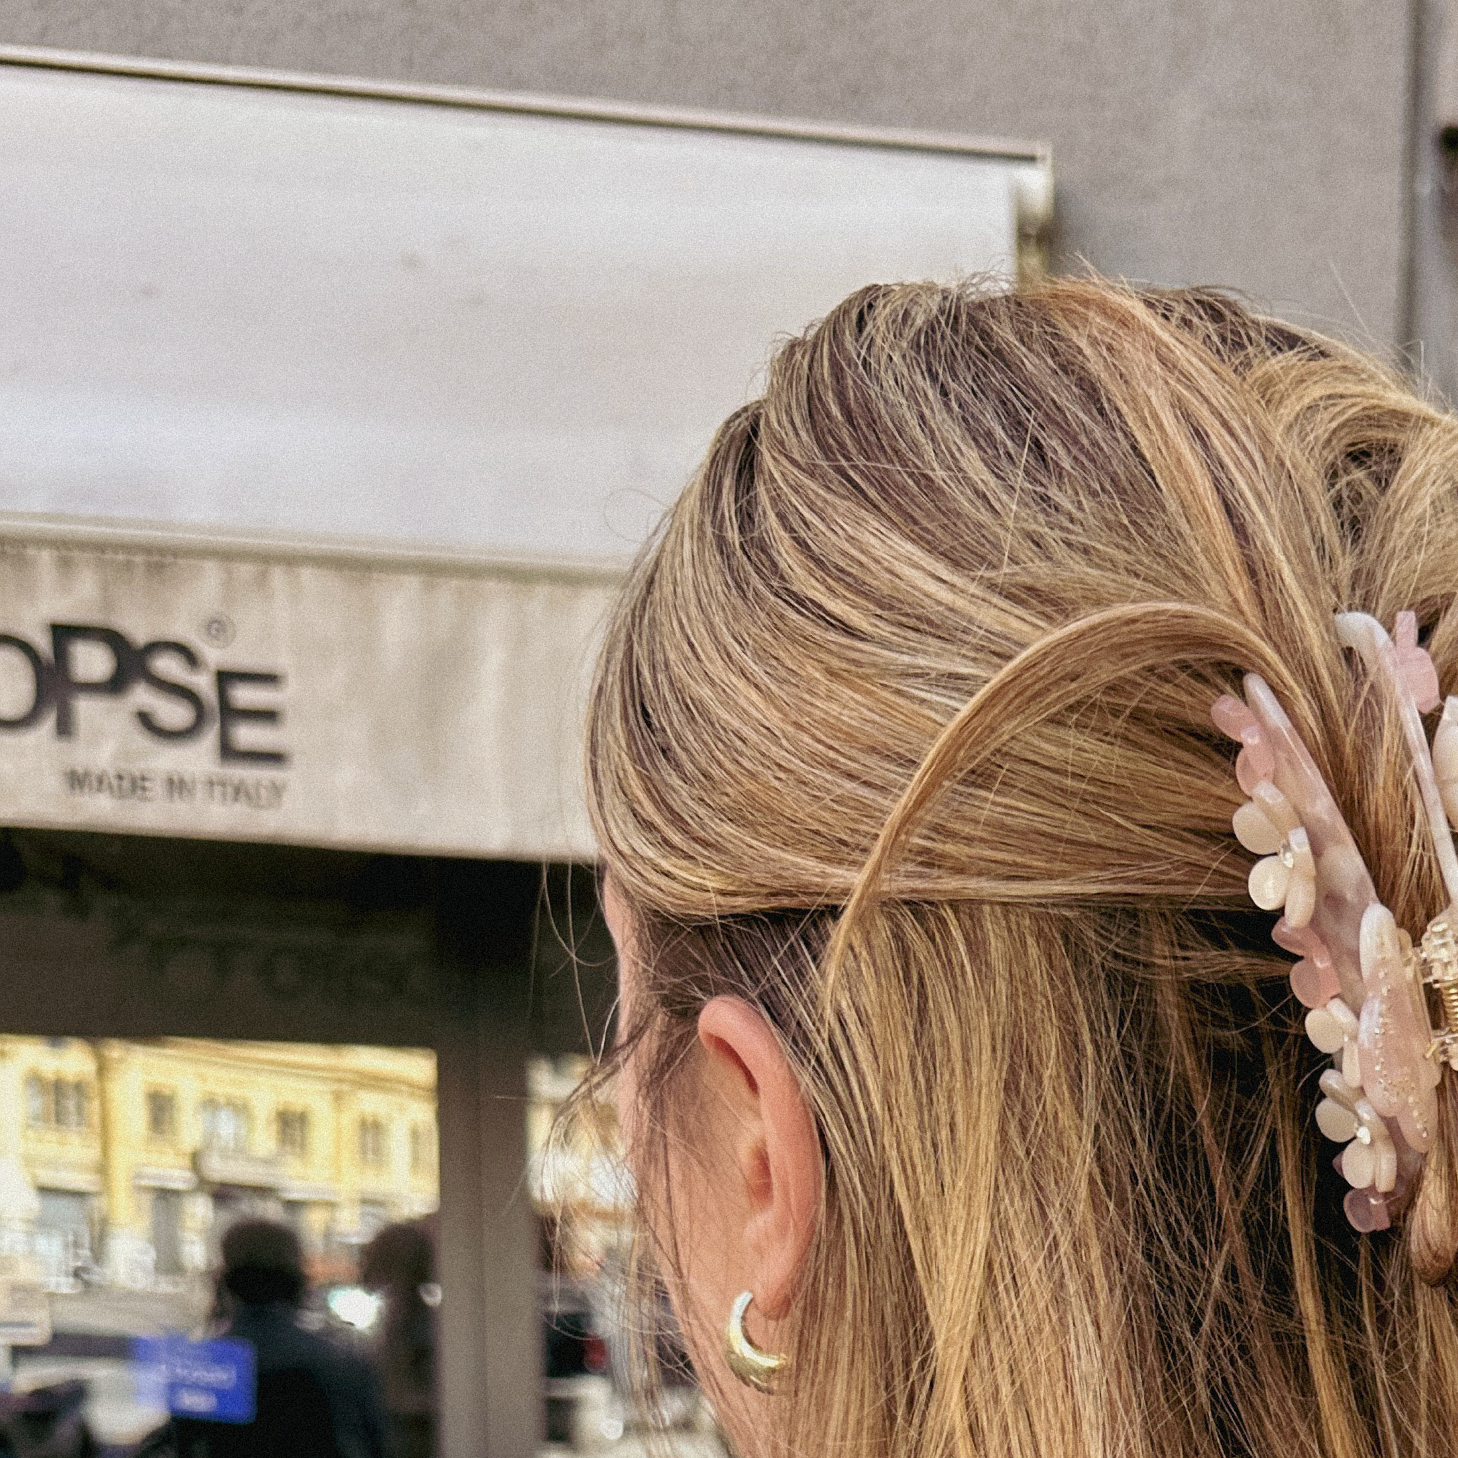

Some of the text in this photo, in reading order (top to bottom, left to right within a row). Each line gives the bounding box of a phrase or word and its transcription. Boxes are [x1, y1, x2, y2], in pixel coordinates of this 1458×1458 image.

[65, 767, 286, 810] MADE IN ITALY
